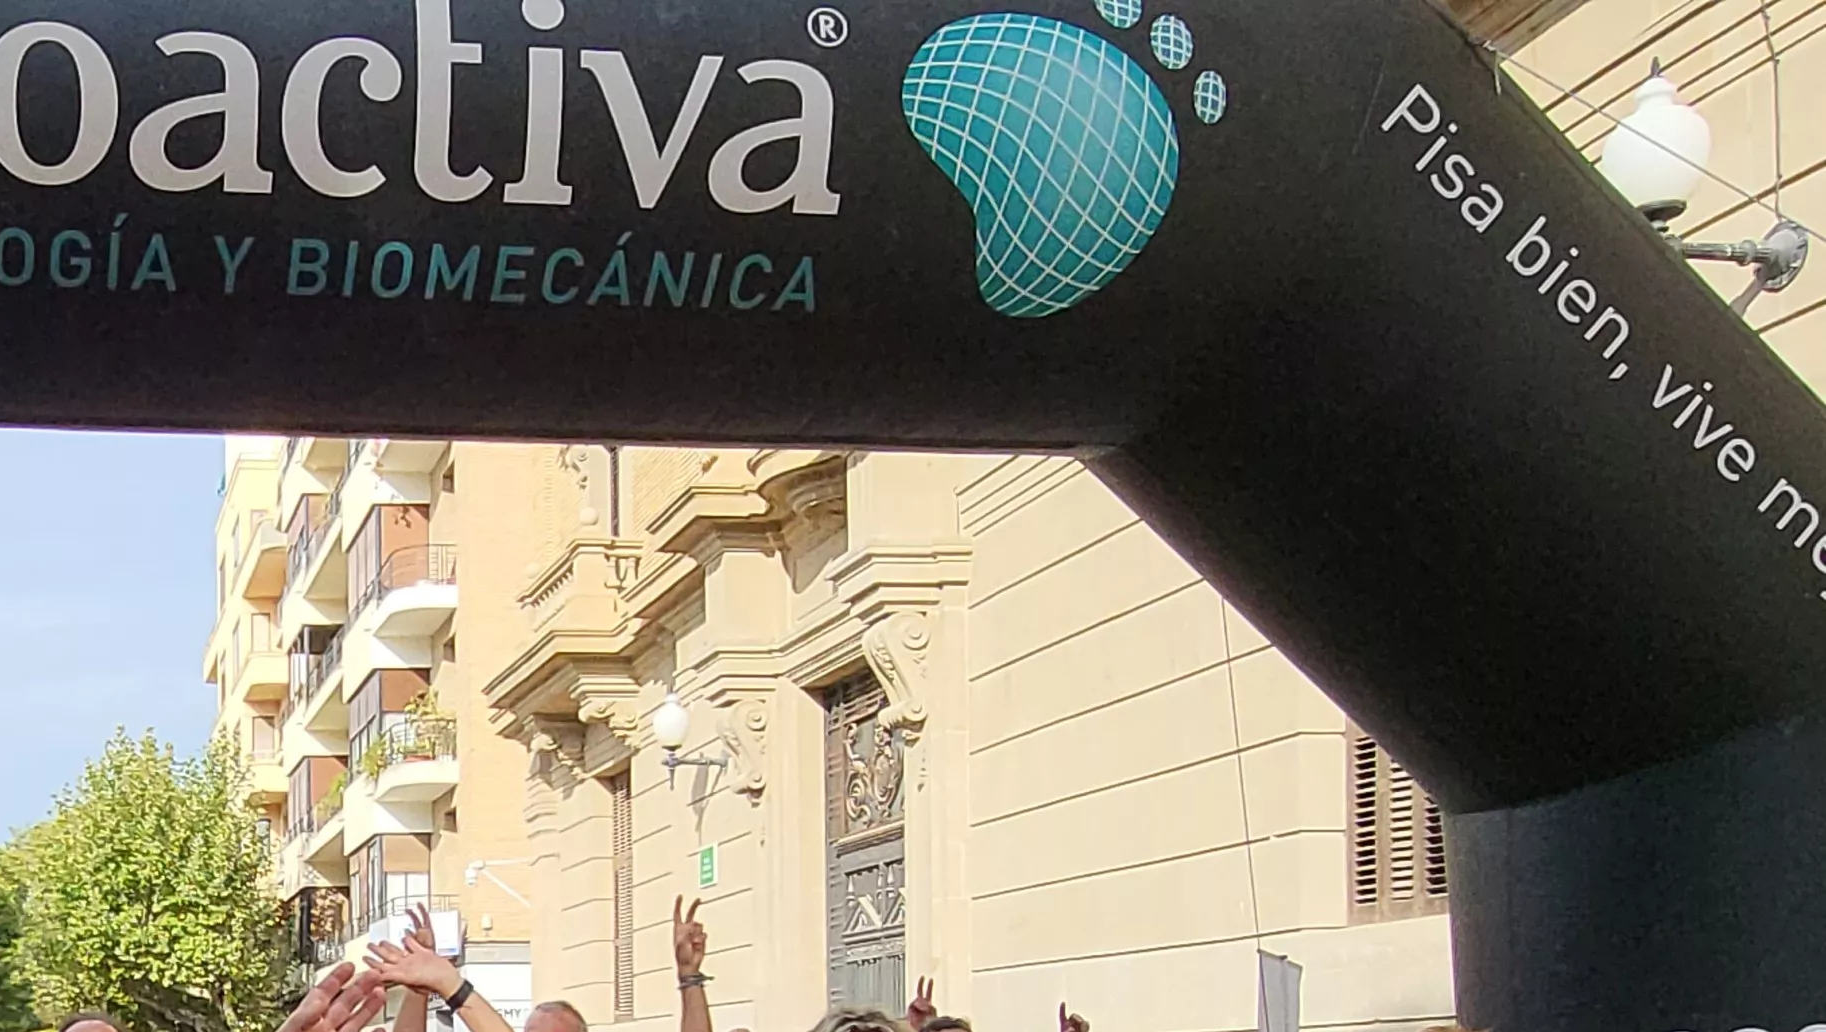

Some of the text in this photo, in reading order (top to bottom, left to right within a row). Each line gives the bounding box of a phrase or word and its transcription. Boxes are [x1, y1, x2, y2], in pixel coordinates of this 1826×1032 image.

[215, 237, 255, 295] Y
[285, 231, 818, 312] BIOMECÁNICA
[1380, 83, 1503, 236] Pisa
[1504, 216, 1631, 381] bien,
[1652, 364, 1758, 482] vive
